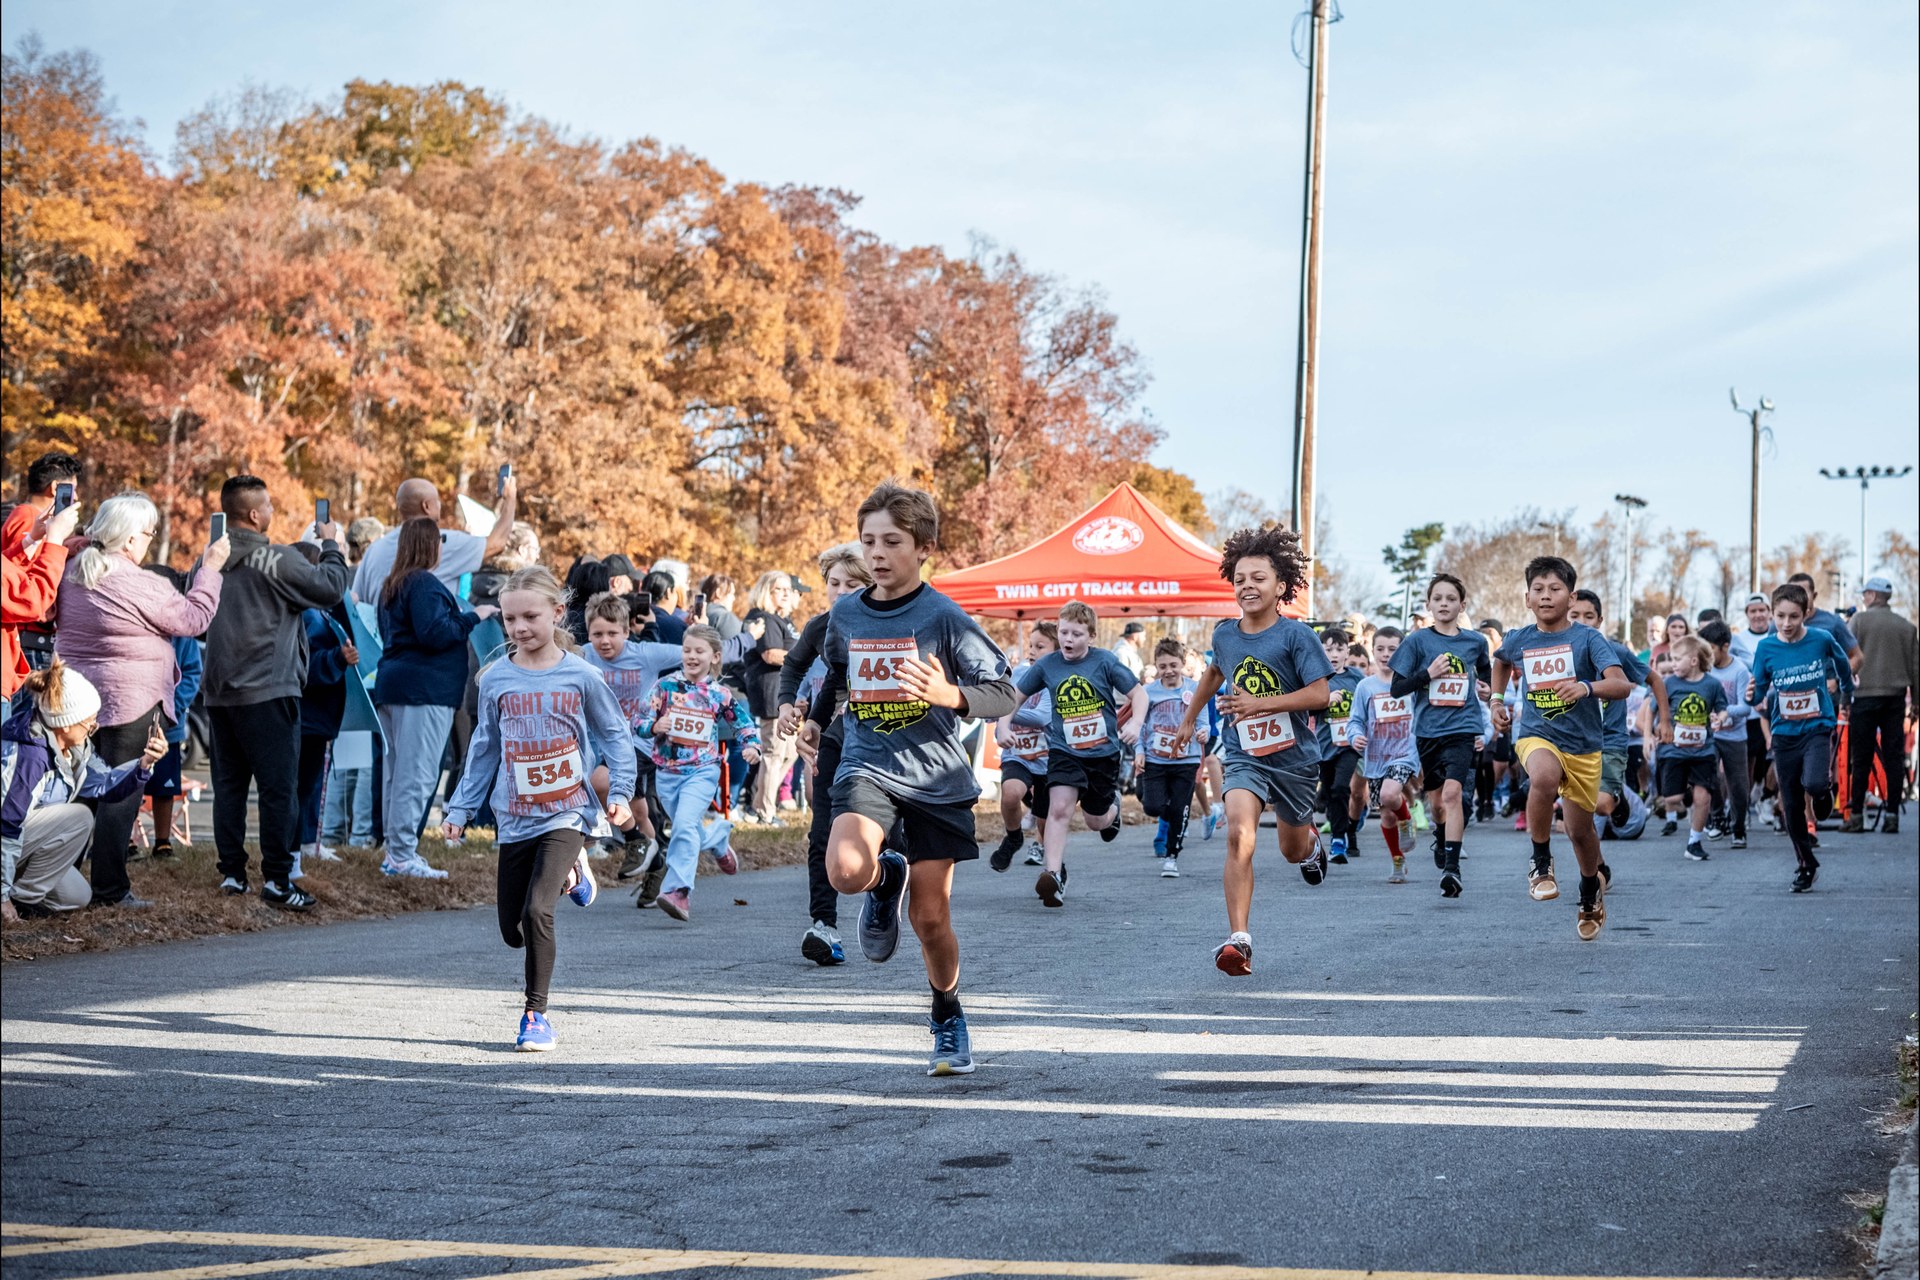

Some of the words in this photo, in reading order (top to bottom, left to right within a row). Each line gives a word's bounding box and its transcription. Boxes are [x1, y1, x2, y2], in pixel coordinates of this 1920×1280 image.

[995, 584, 1039, 599] TWIN
[1043, 583, 1078, 597] CITY
[1081, 581, 1135, 596] TRACK
[1138, 581, 1181, 595] CLUB
[858, 657, 905, 681] 463
[1532, 657, 1565, 676] 460
[1437, 682, 1463, 695] 447
[501, 692, 543, 717] FIGHT
[551, 692, 581, 715] THE
[849, 702, 882, 714] LACK
[883, 699, 932, 712] KNIGH
[1381, 699, 1405, 712] 424
[1786, 698, 1811, 711] 427
[674, 717, 705, 735] 559
[1072, 722, 1098, 739] 437
[1247, 719, 1282, 742] 576
[1679, 731, 1701, 741] 443
[530, 752, 543, 760] CITY
[544, 748, 562, 758] TRACK
[527, 759, 573, 787] 534
